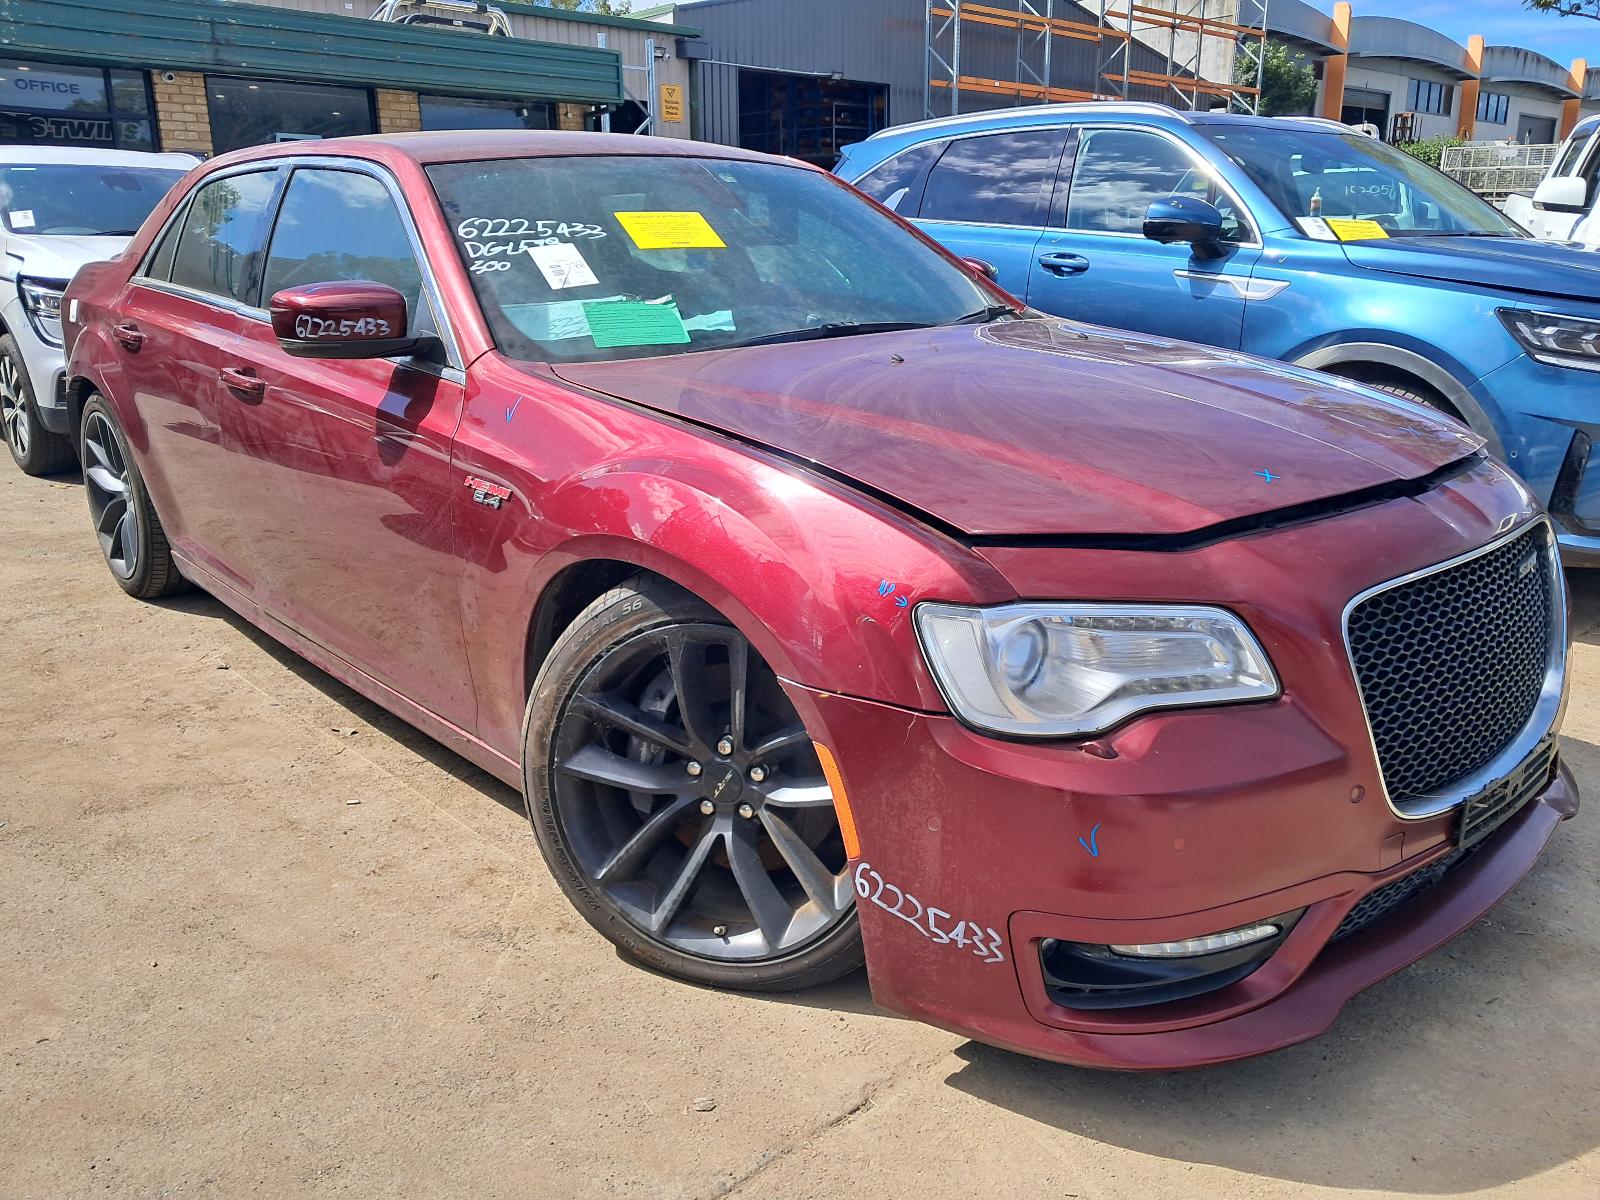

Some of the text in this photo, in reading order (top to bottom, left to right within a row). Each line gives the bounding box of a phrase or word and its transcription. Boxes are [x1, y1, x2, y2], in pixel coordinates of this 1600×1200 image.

[14, 78, 80, 94] OFFICE
[458, 217, 608, 240] 62225433
[295, 315, 391, 337] 62225433
[463, 475, 513, 500] HEMI
[473, 489, 501, 509] 6.4
[621, 599, 642, 616] 56
[855, 863, 1005, 963] 62225433
